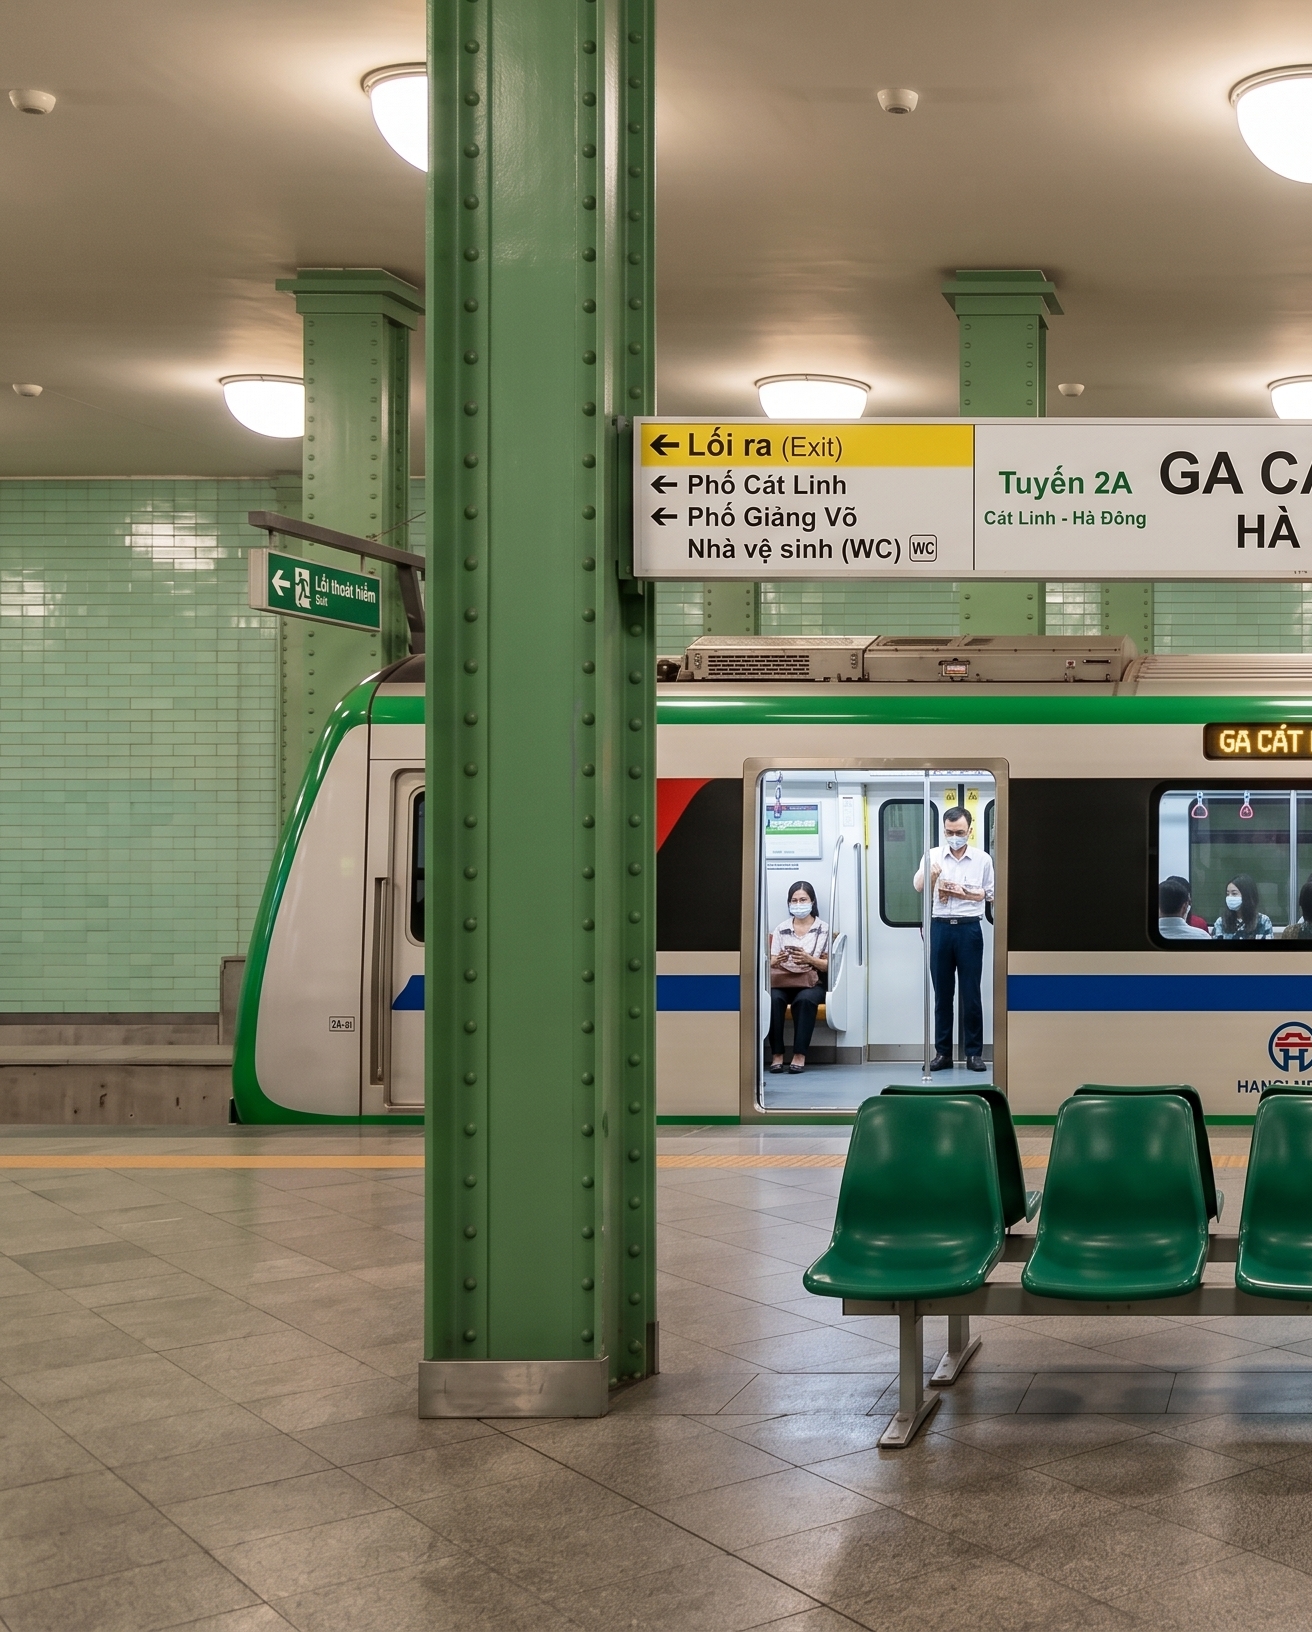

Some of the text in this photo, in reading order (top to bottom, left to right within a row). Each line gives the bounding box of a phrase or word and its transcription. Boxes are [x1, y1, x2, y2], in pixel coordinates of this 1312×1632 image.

[688, 427, 843, 463] Lối ra (Exit)
[688, 470, 847, 495] Phố Cát Linh
[998, 465, 1133, 500] Tuyến 2A
[1159, 450, 1244, 495] GA
[688, 502, 857, 533] Phố Giảng Võ
[984, 510, 1013, 525] Cát
[1019, 510, 1056, 525] Linh
[1073, 510, 1095, 525] Hà
[1100, 510, 1147, 529] Đông
[1237, 505, 1301, 549] HÀ
[688, 538, 901, 565] Nhà vệ sinh (WC)
[912, 541, 935, 556] WC
[1219, 730, 1252, 753] GA
[1257, 724, 1304, 753] CÁT
